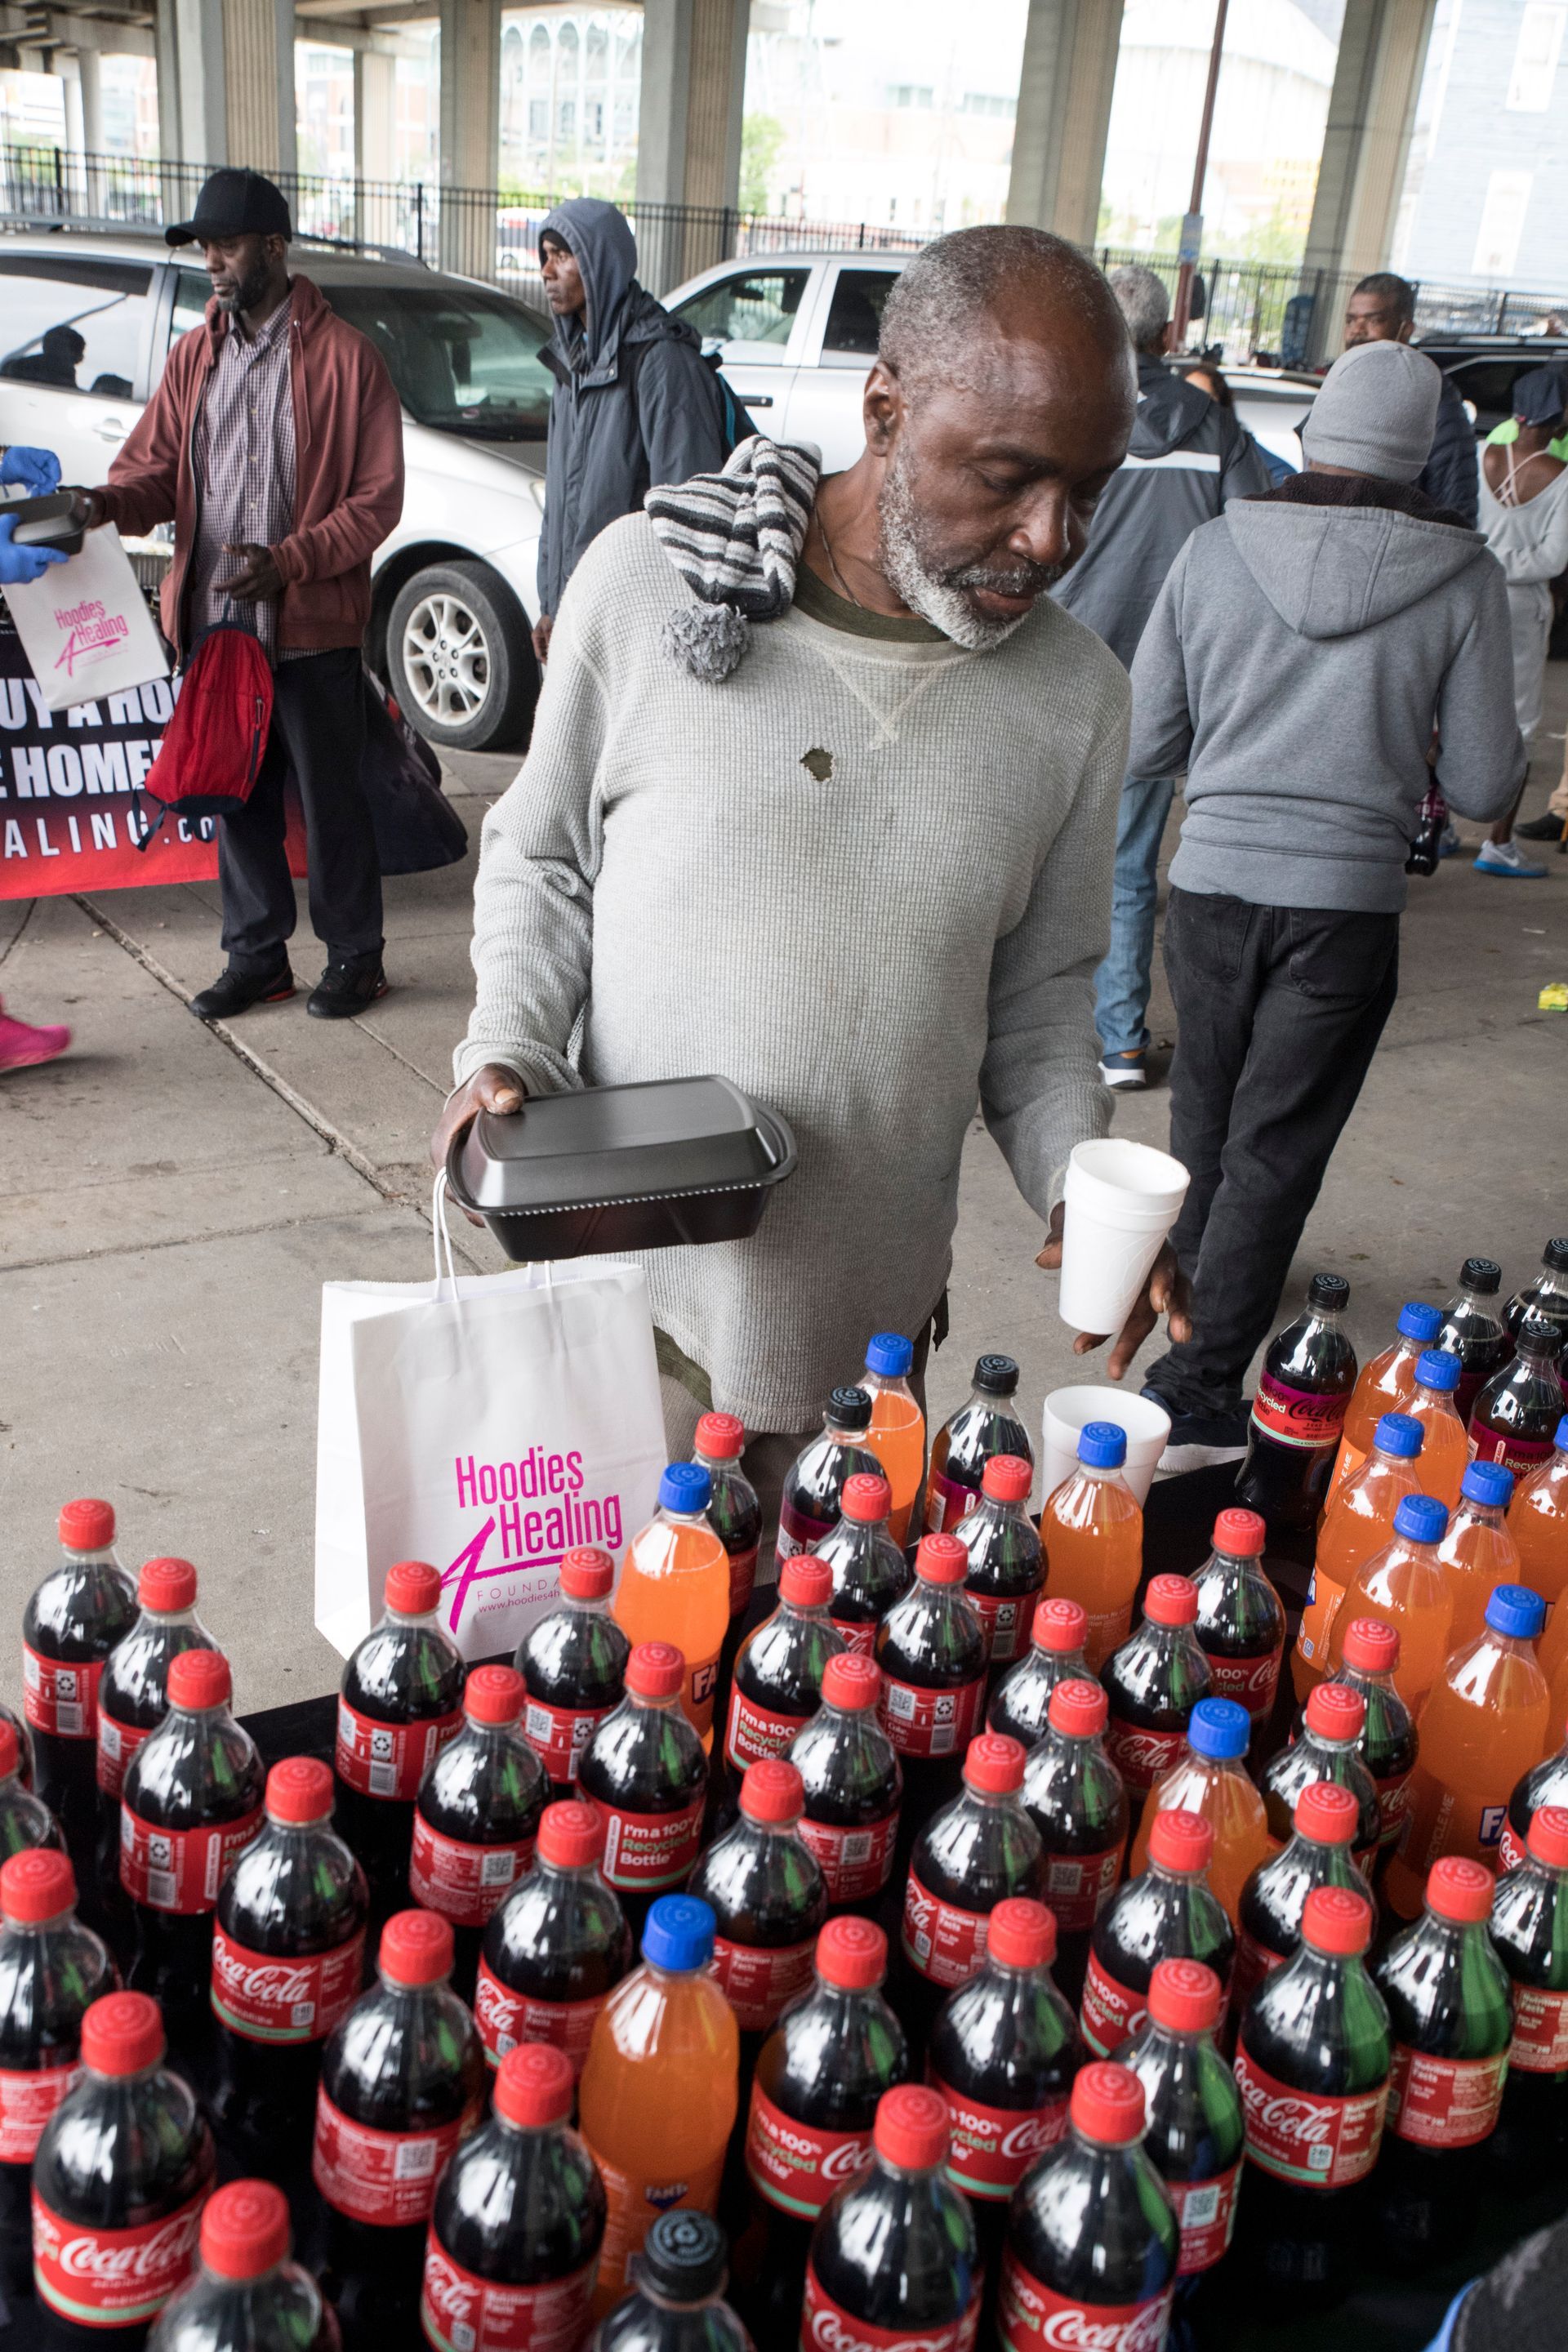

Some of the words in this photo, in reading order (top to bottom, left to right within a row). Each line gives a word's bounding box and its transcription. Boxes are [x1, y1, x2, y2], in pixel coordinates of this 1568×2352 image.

[55, 599, 106, 630] Hoodies
[76, 612, 129, 647] Healing
[456, 1446, 584, 1508] Hoodies
[499, 1491, 623, 1559] Healing
[622, 1823, 649, 1839] I'm
